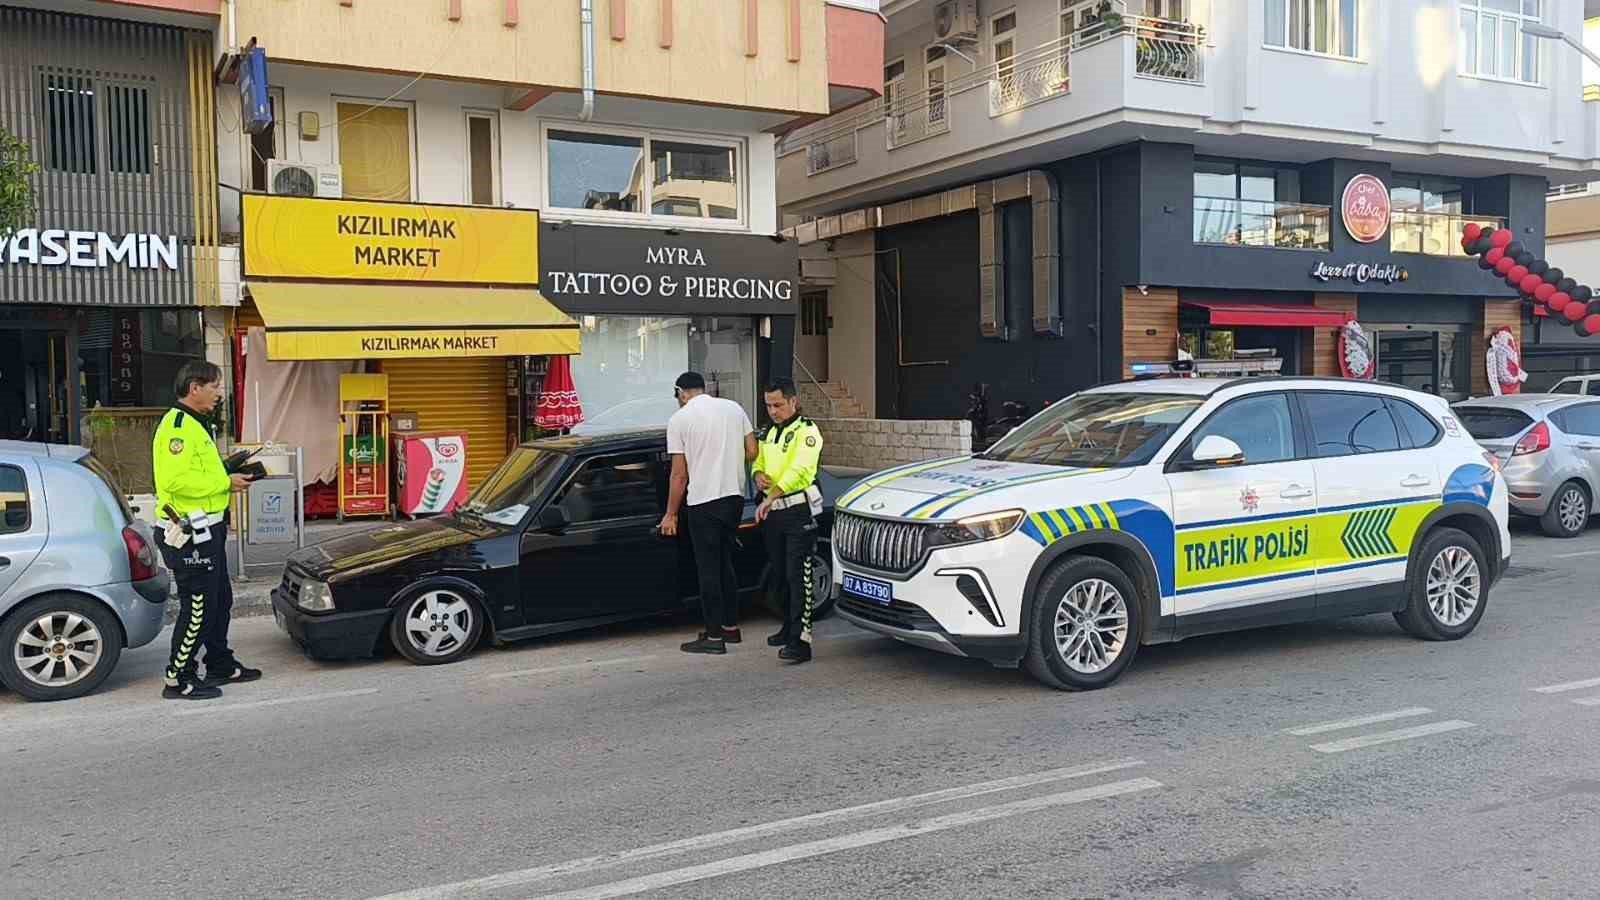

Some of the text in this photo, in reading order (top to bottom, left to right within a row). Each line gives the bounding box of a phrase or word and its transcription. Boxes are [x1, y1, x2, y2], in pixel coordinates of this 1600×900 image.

[337, 214, 456, 239] KIZILIRMAK
[354, 245, 441, 268] MARKET
[645, 247, 707, 266] MYRA
[548, 271, 792, 300] TATTOO & PIERCING
[361, 335, 498, 351] KIZILIRMAK MARKET
[1183, 523, 1309, 572] TRAFİK POLİSİ
[854, 580, 862, 592] A
[862, 581, 889, 599] 83790
